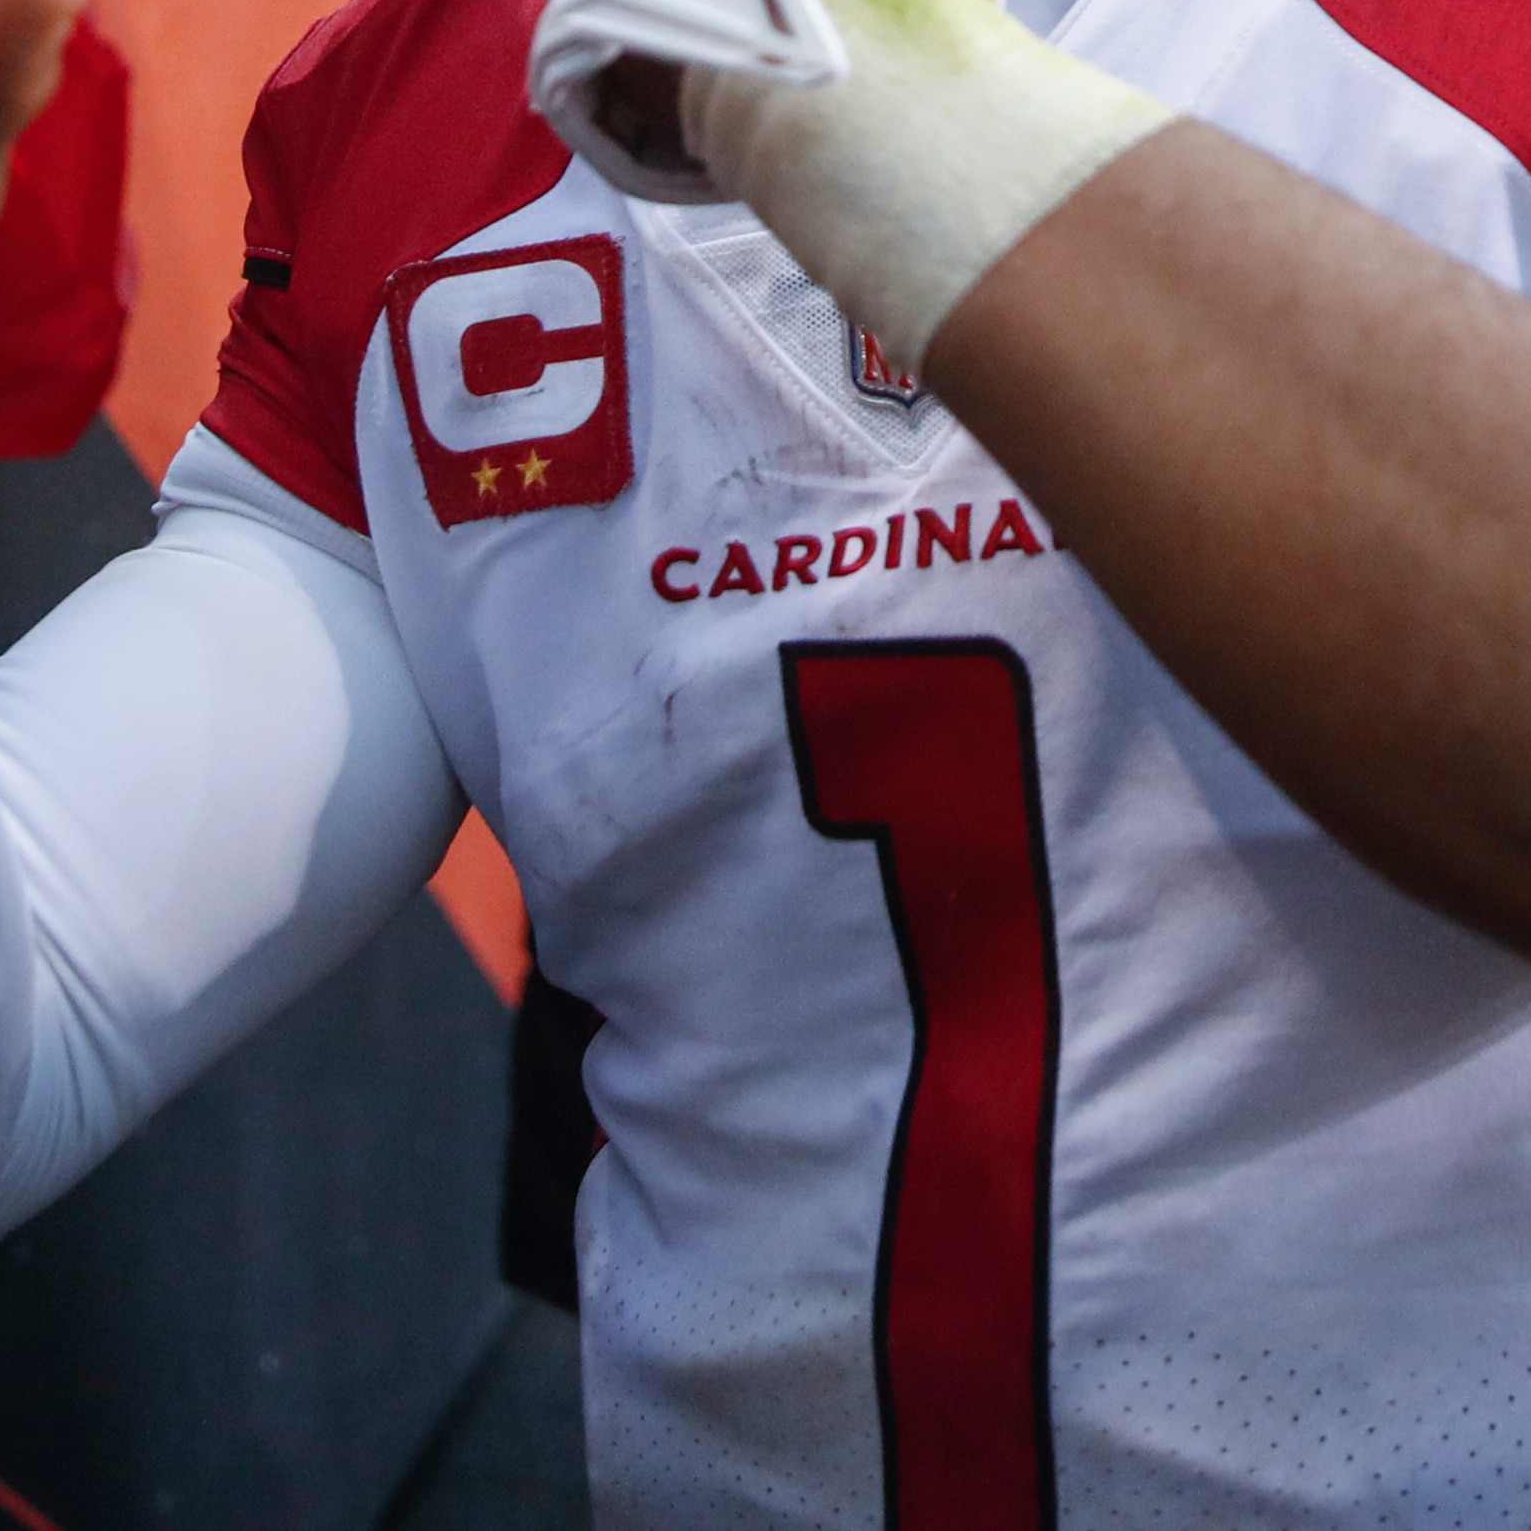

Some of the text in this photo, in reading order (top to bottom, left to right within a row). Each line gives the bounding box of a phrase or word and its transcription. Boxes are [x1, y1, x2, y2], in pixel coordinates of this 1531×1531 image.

[407, 258, 606, 453] C
[650, 497, 1054, 603] CARDINA
[778, 635, 1061, 1531] 1
